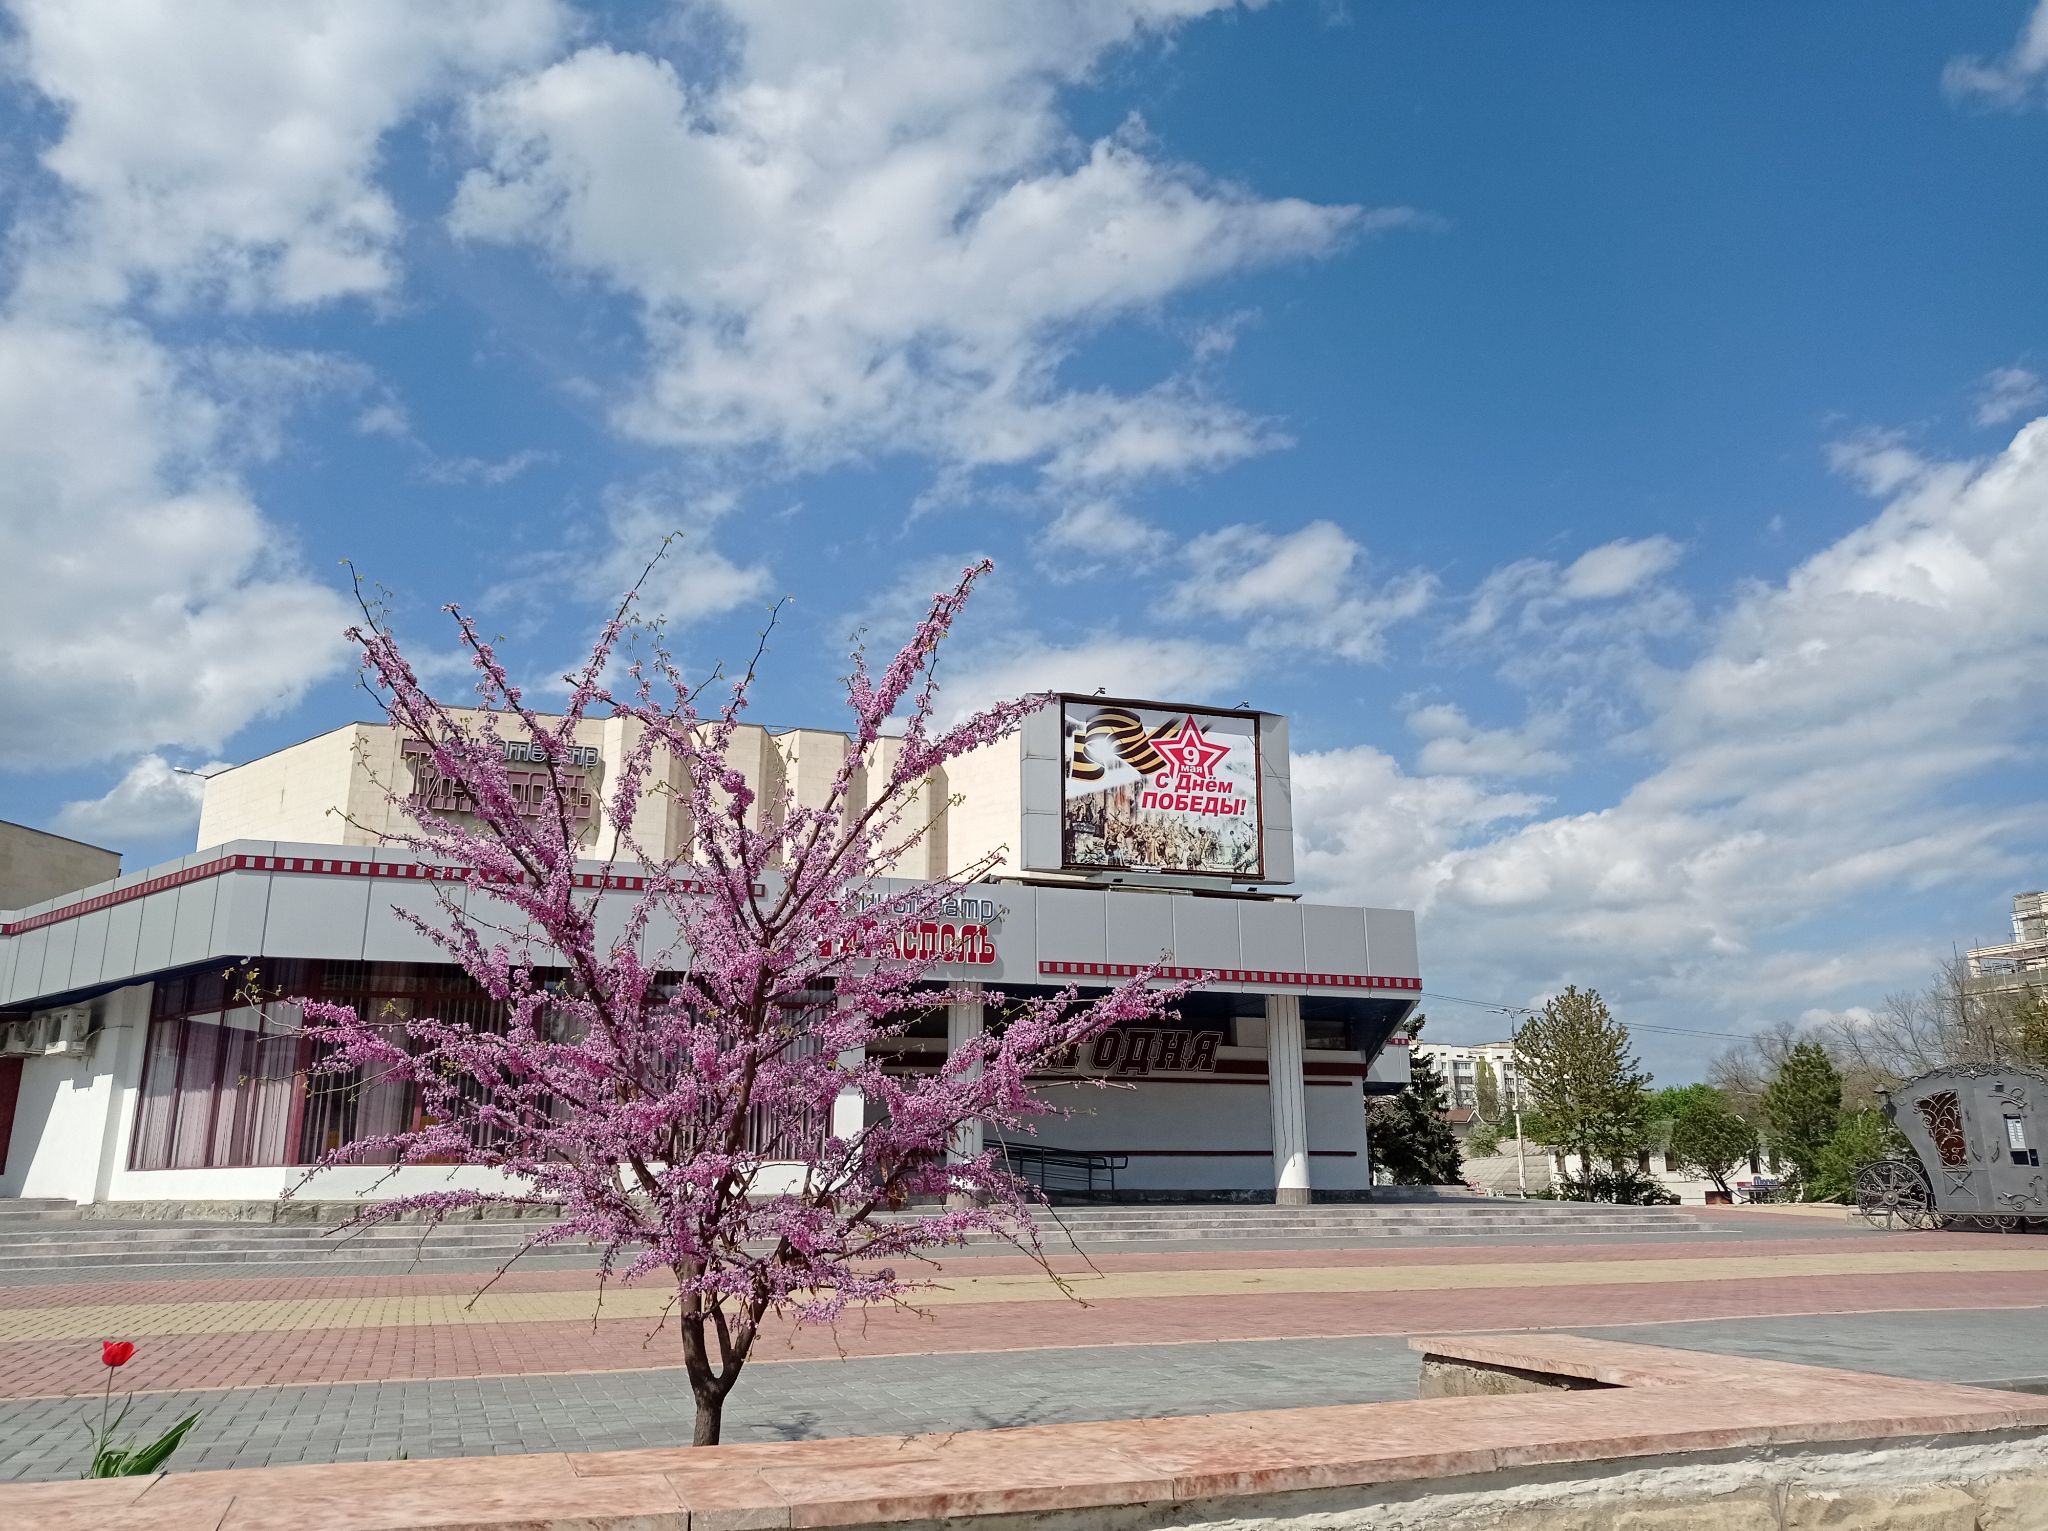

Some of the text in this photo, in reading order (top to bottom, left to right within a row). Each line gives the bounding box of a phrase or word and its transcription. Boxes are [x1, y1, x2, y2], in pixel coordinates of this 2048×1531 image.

[1182, 746, 1200, 766] 9
[1181, 765, 1203, 773] мая
[1174, 774, 1233, 794] Днём
[1141, 791, 1247, 817] ПОБЕДЫ!
[1012, 1023, 1223, 1077] ГОДНЯ
